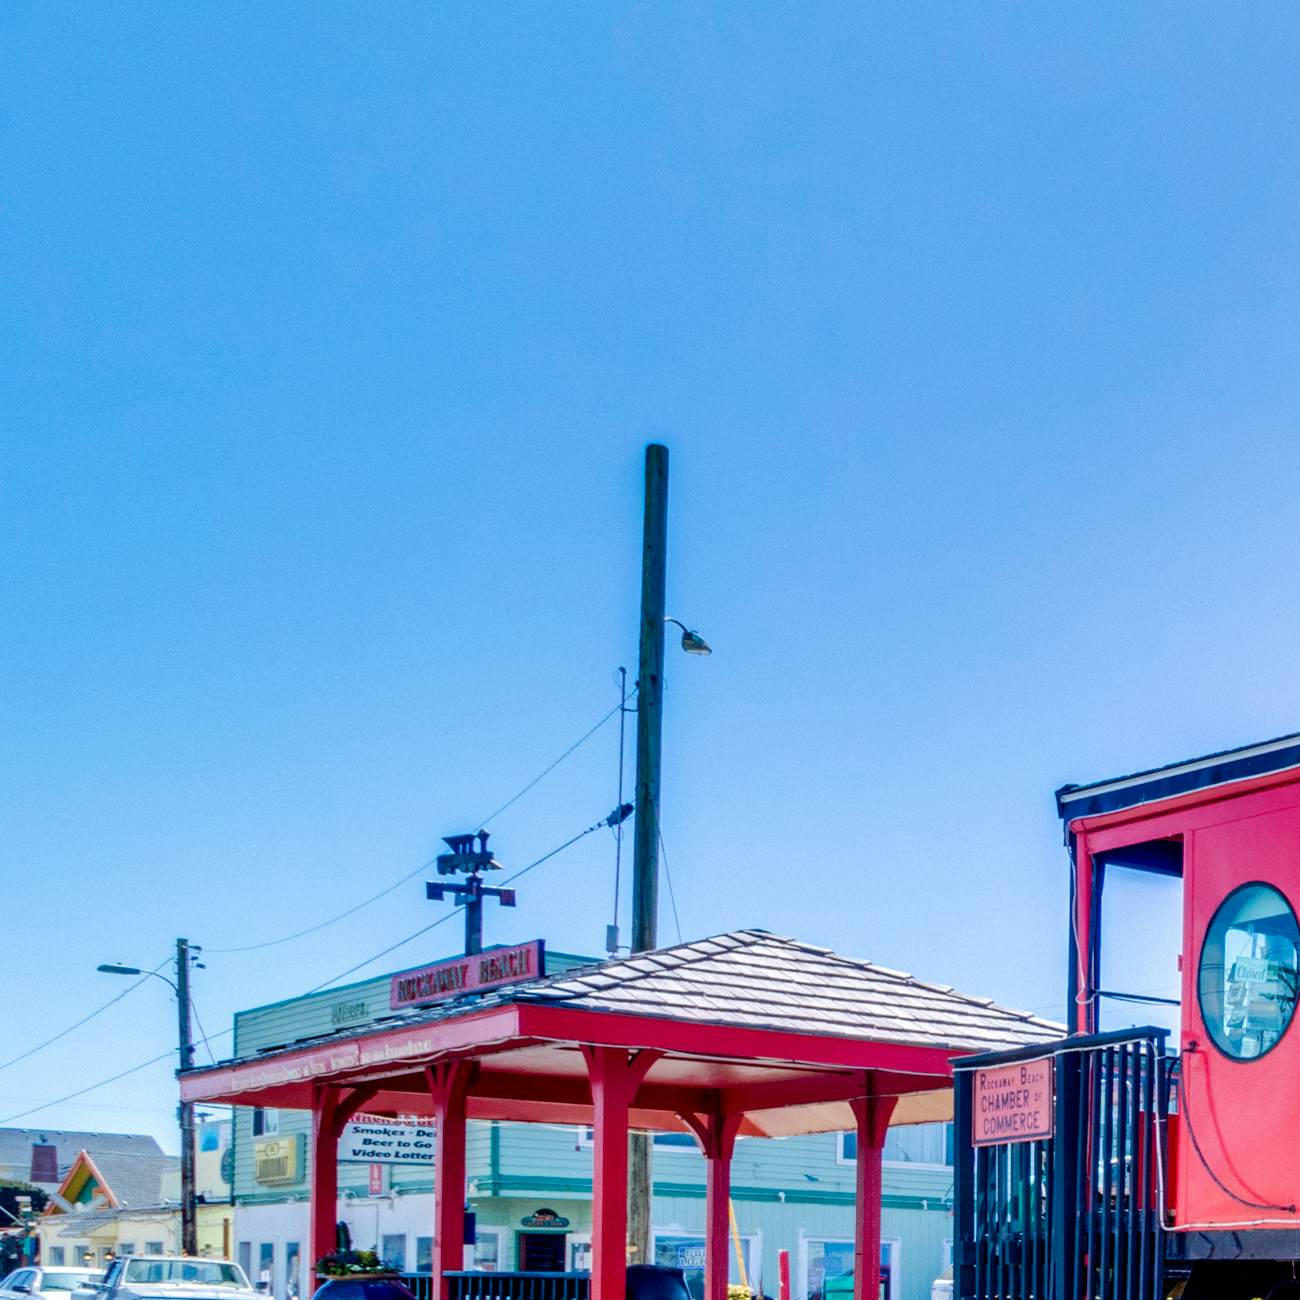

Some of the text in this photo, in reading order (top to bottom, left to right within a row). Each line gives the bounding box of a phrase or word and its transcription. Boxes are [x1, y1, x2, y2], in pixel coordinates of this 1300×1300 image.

[398, 948, 531, 1002] ROCKAWAY BEACH
[1237, 965, 1266, 982] Closed
[981, 1089, 1030, 1113] CHAMBER
[983, 1111, 1040, 1135] COMMERCE
[352, 1126, 405, 1138] Smokes
[362, 1138, 432, 1149] Beer to Go
[352, 1149, 435, 1160] Video Lotter
